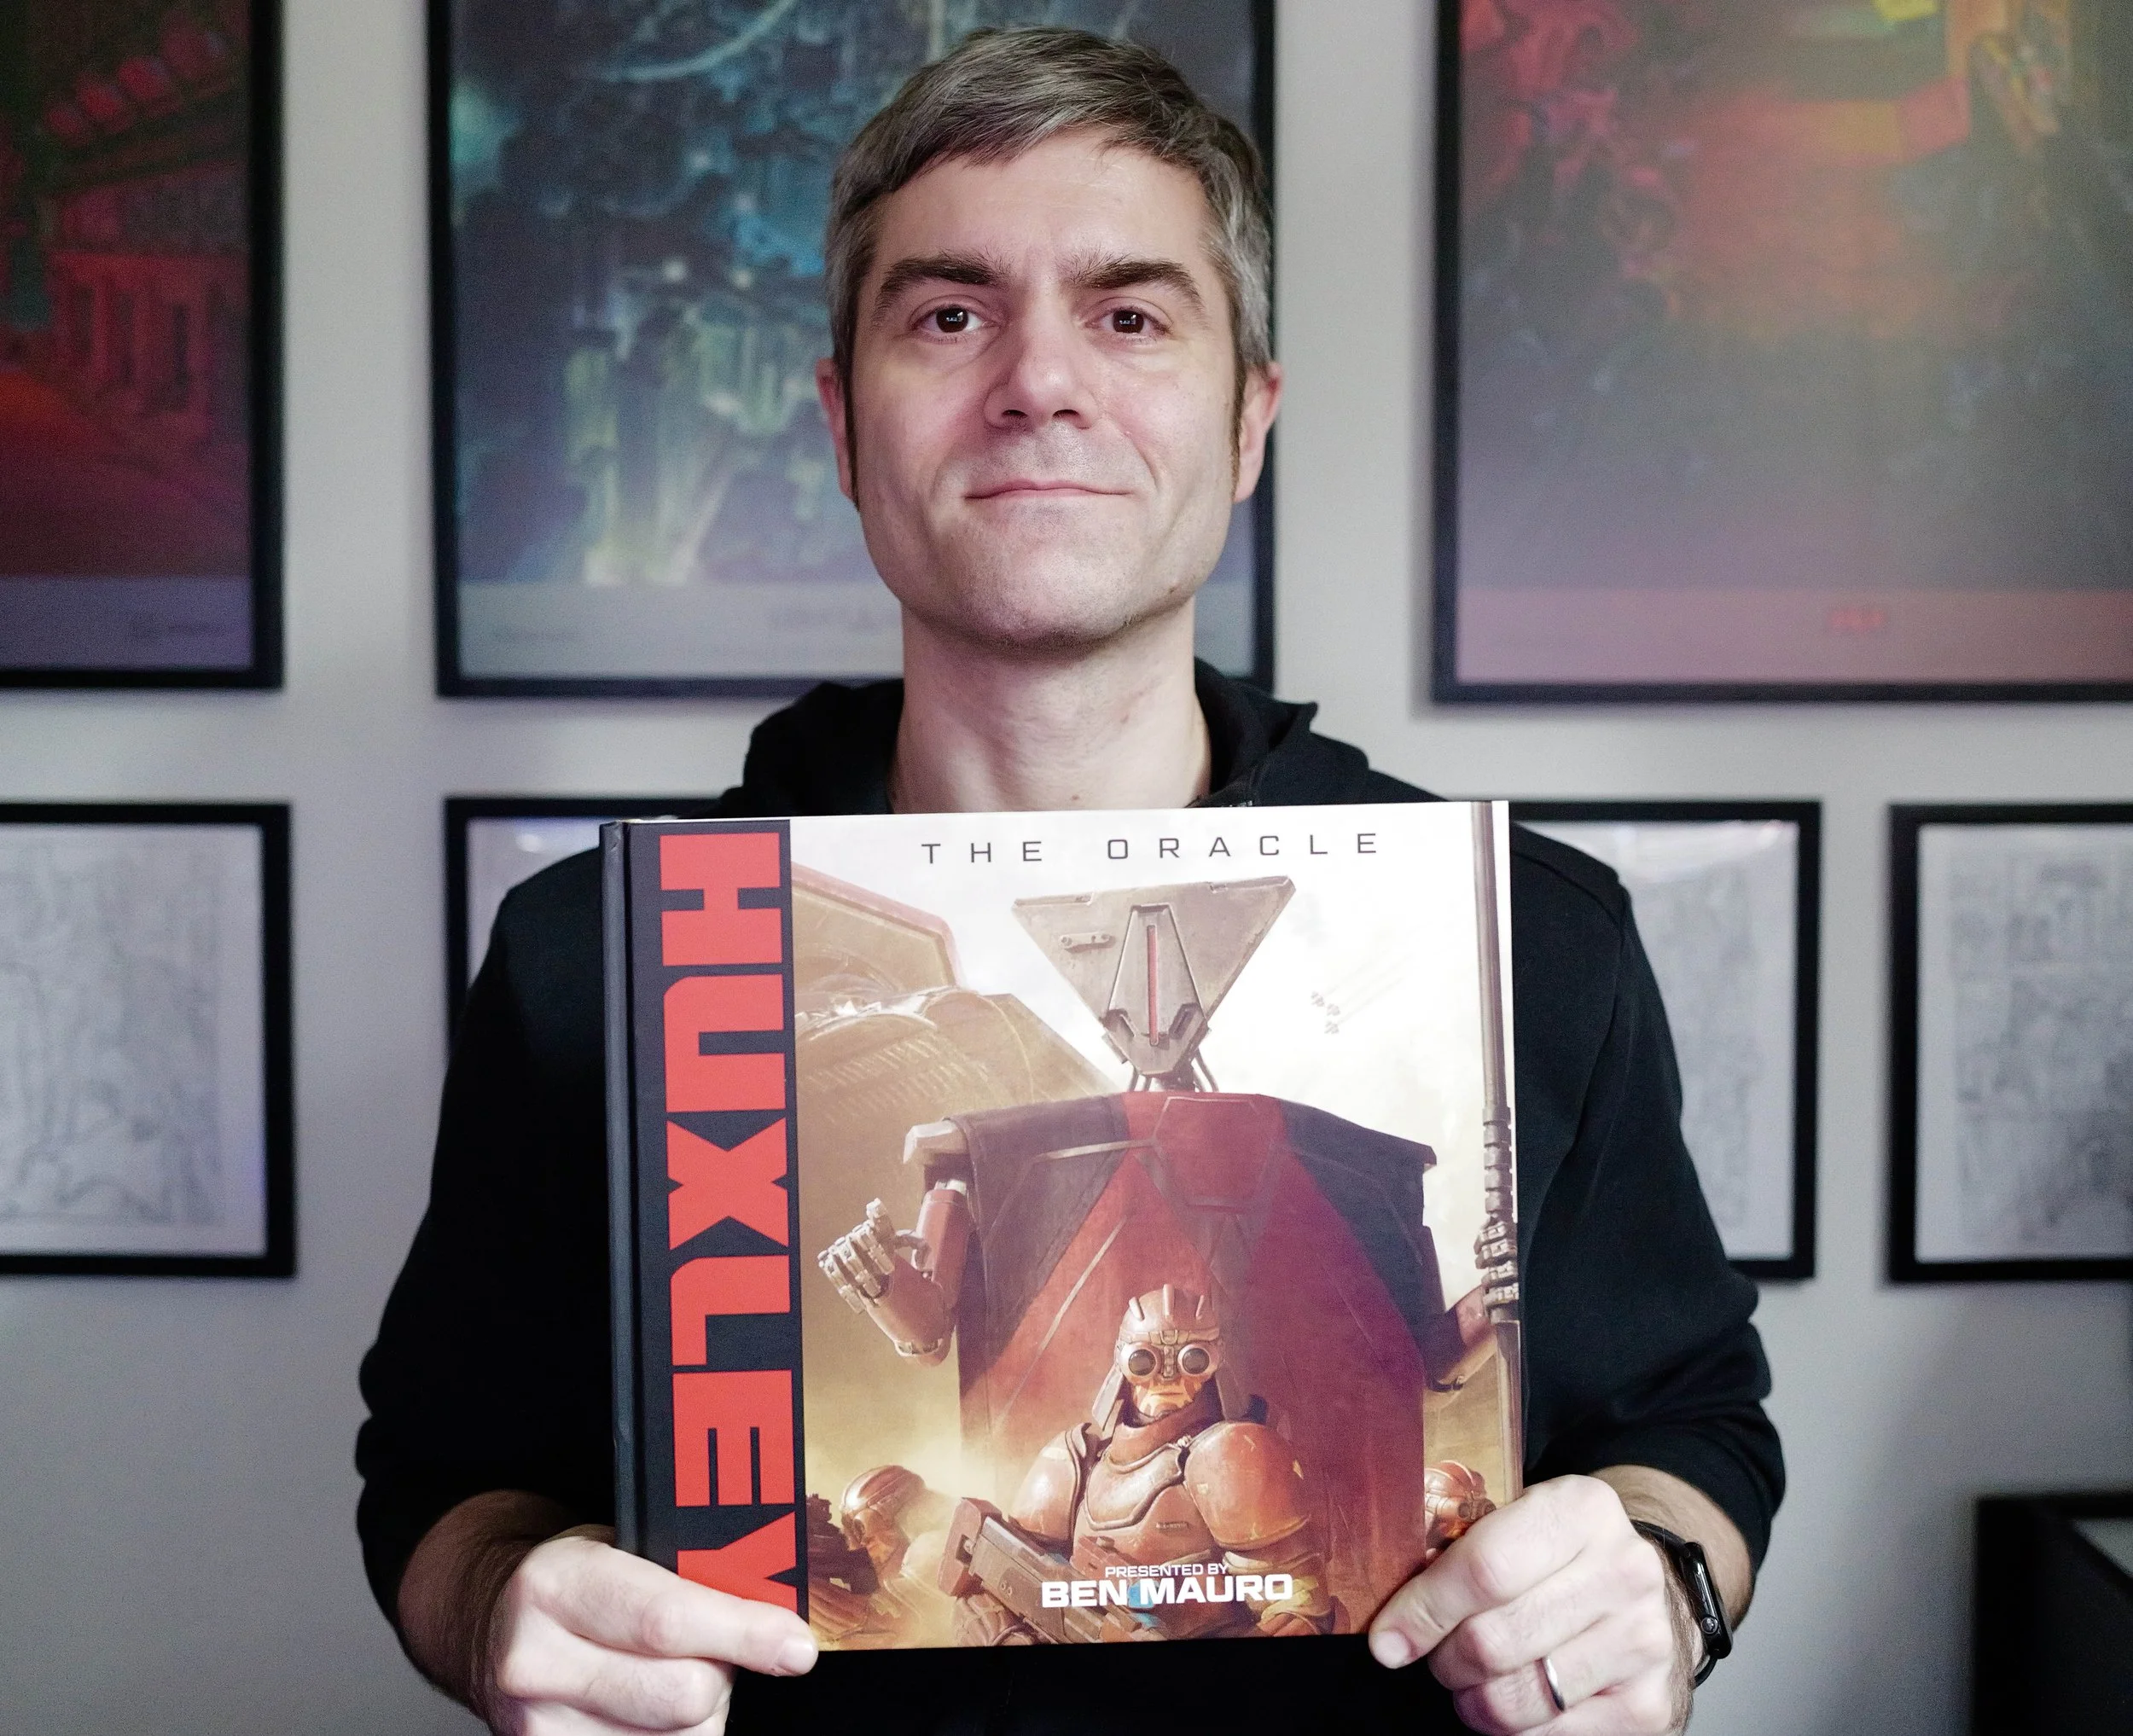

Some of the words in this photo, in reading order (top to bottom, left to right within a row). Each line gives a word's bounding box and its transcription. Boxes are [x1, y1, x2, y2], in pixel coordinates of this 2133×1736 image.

[921, 840, 1043, 864] THE
[1107, 833, 1377, 860] ORACLE
[660, 832, 797, 1612] HUXLEY
[1105, 1564, 1204, 1578] PRESENTED
[1207, 1563, 1229, 1575] BY
[1042, 1578, 1127, 1608] BEN
[1139, 1573, 1294, 1605] MAURO
